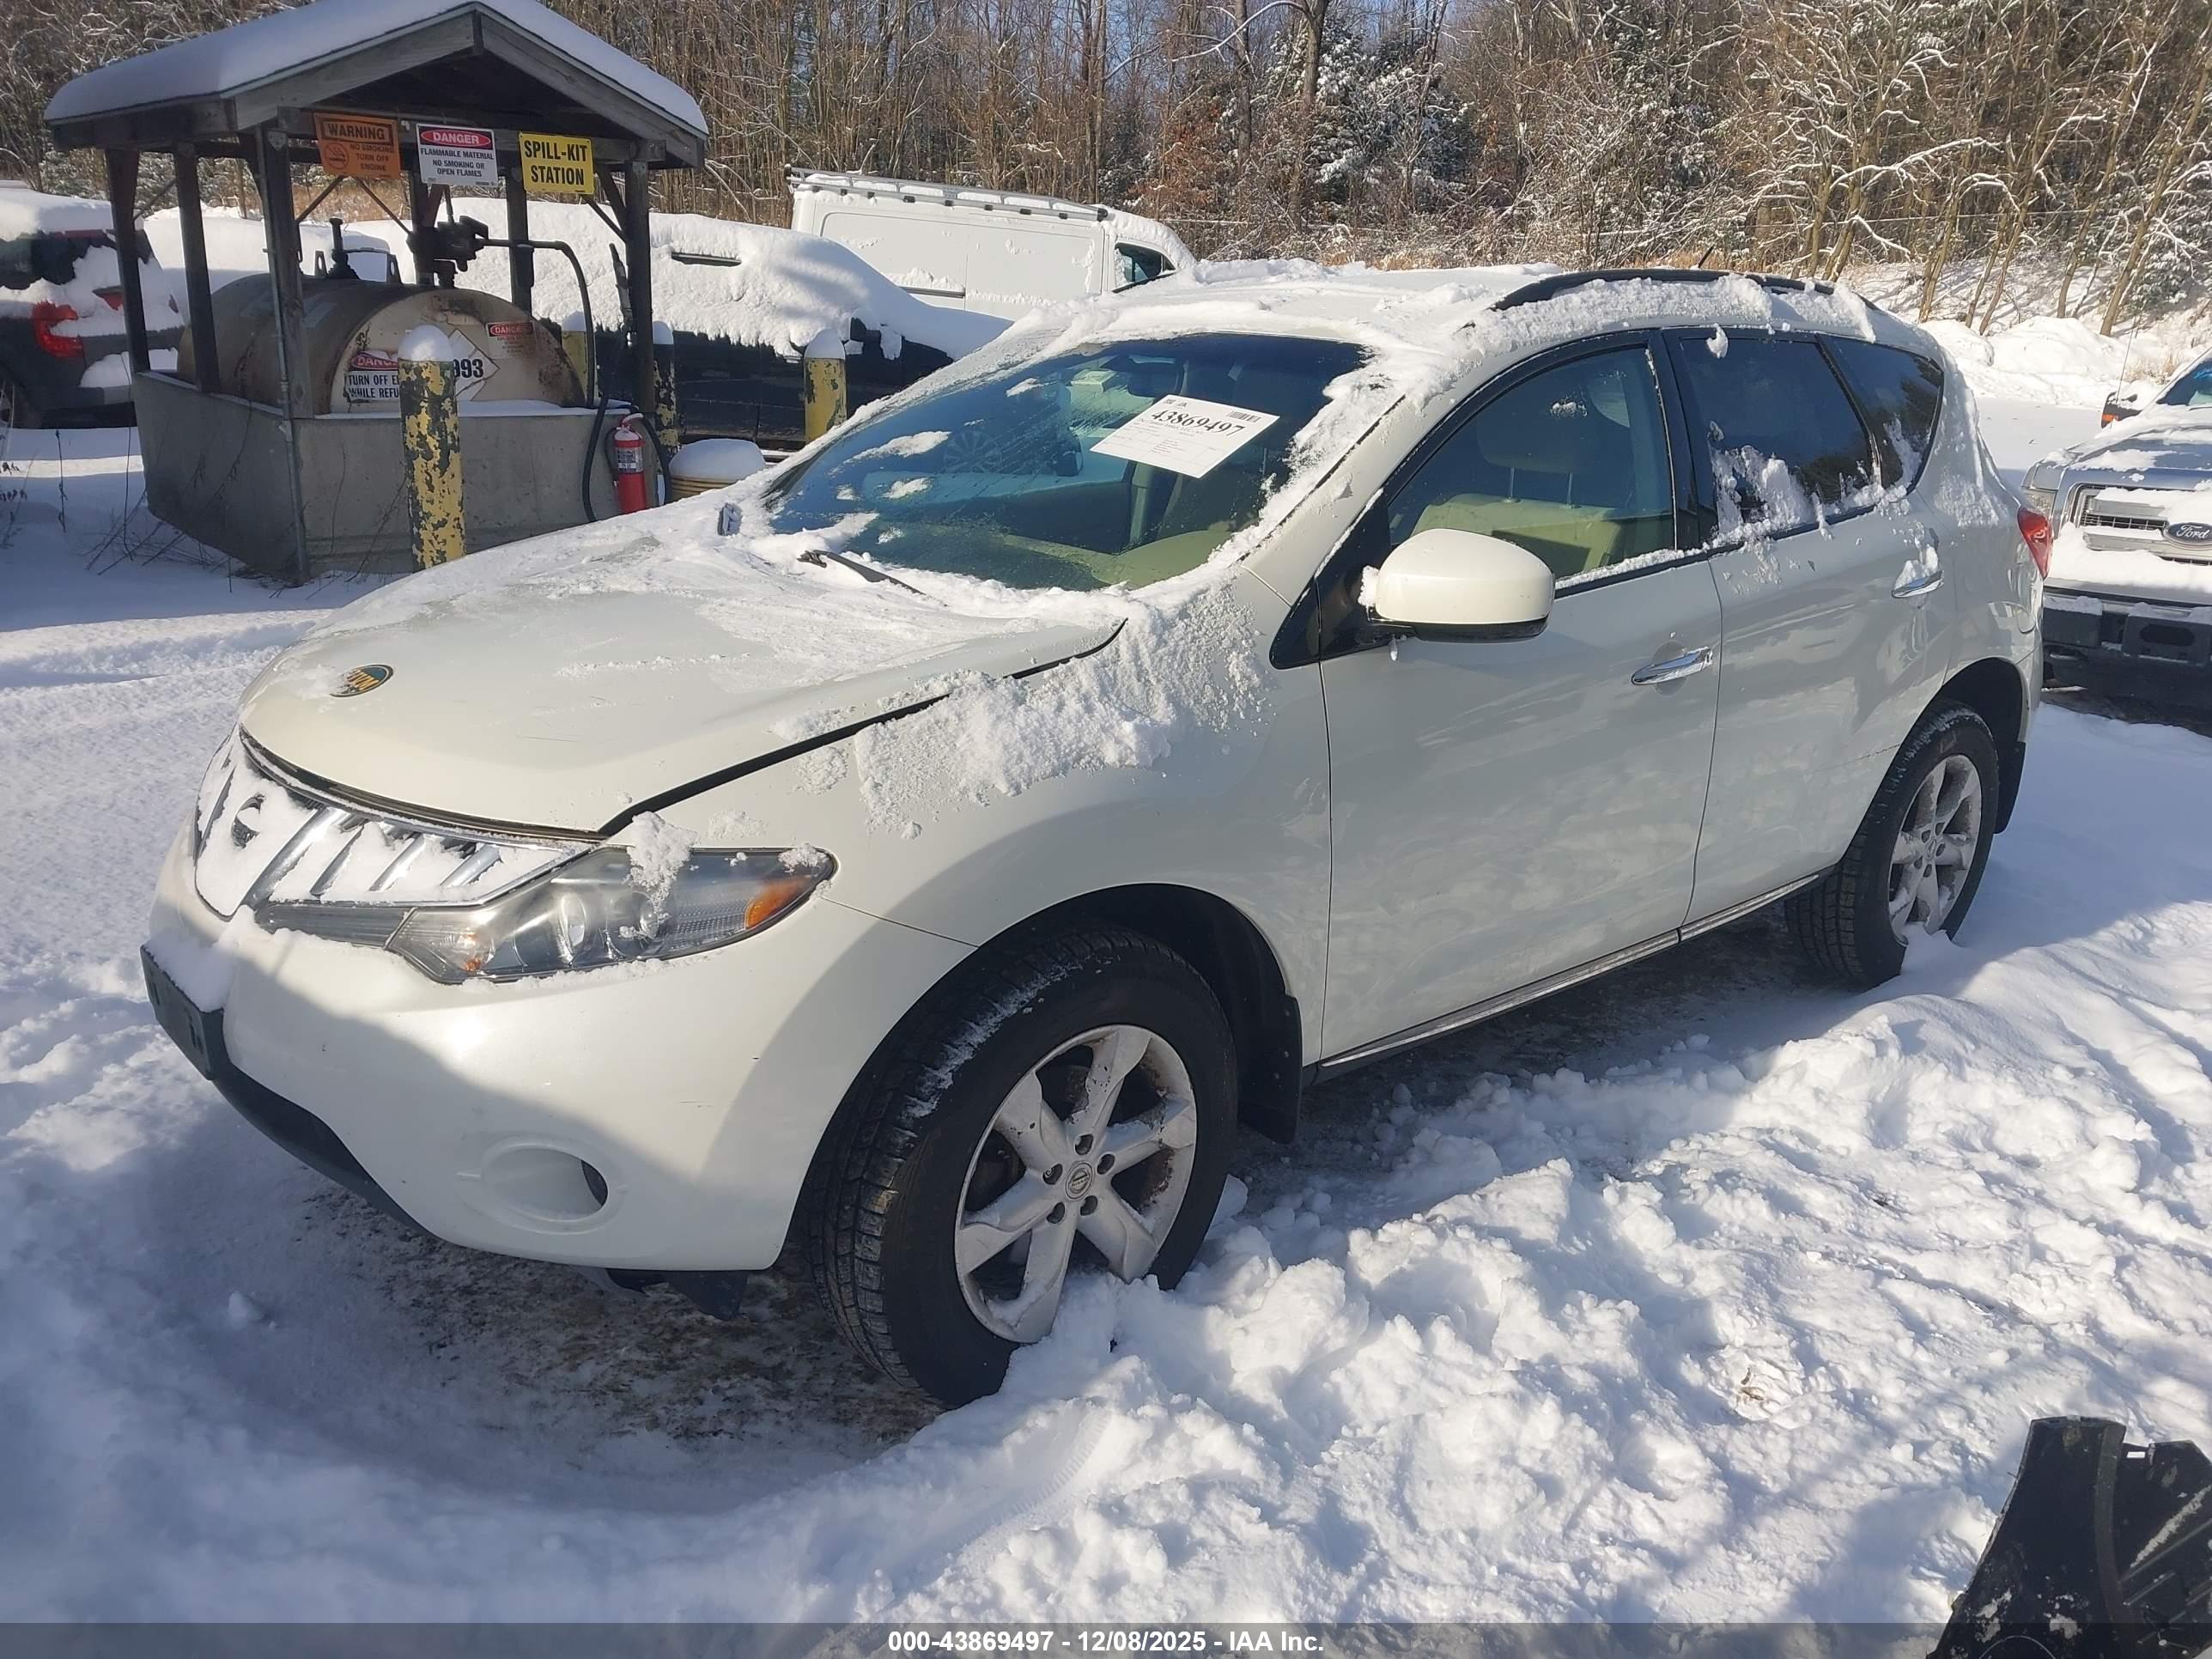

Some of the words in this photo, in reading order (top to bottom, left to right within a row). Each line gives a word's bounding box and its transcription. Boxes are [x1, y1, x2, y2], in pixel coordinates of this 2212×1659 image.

[327, 123, 386, 140] WARNING
[432, 131, 480, 144] DANGER
[356, 153, 374, 161] TURN
[421, 148, 462, 158] FLAMMABLE
[463, 150, 495, 160] MATERIAL
[524, 140, 587, 161] SPILL-KIT
[444, 160, 474, 169] SMOKING
[437, 167, 455, 176] OPEN
[457, 169, 483, 178] FLAMES
[530, 164, 585, 185] STATION
[453, 358, 484, 379] 993
[349, 374, 370, 386] TURN
[373, 374, 388, 386] OFF
[349, 387, 376, 398] WHILE
[378, 387, 399, 398] REFU
[1151, 410, 1246, 436] 43869497
[2176, 524, 2210, 538] Ford
